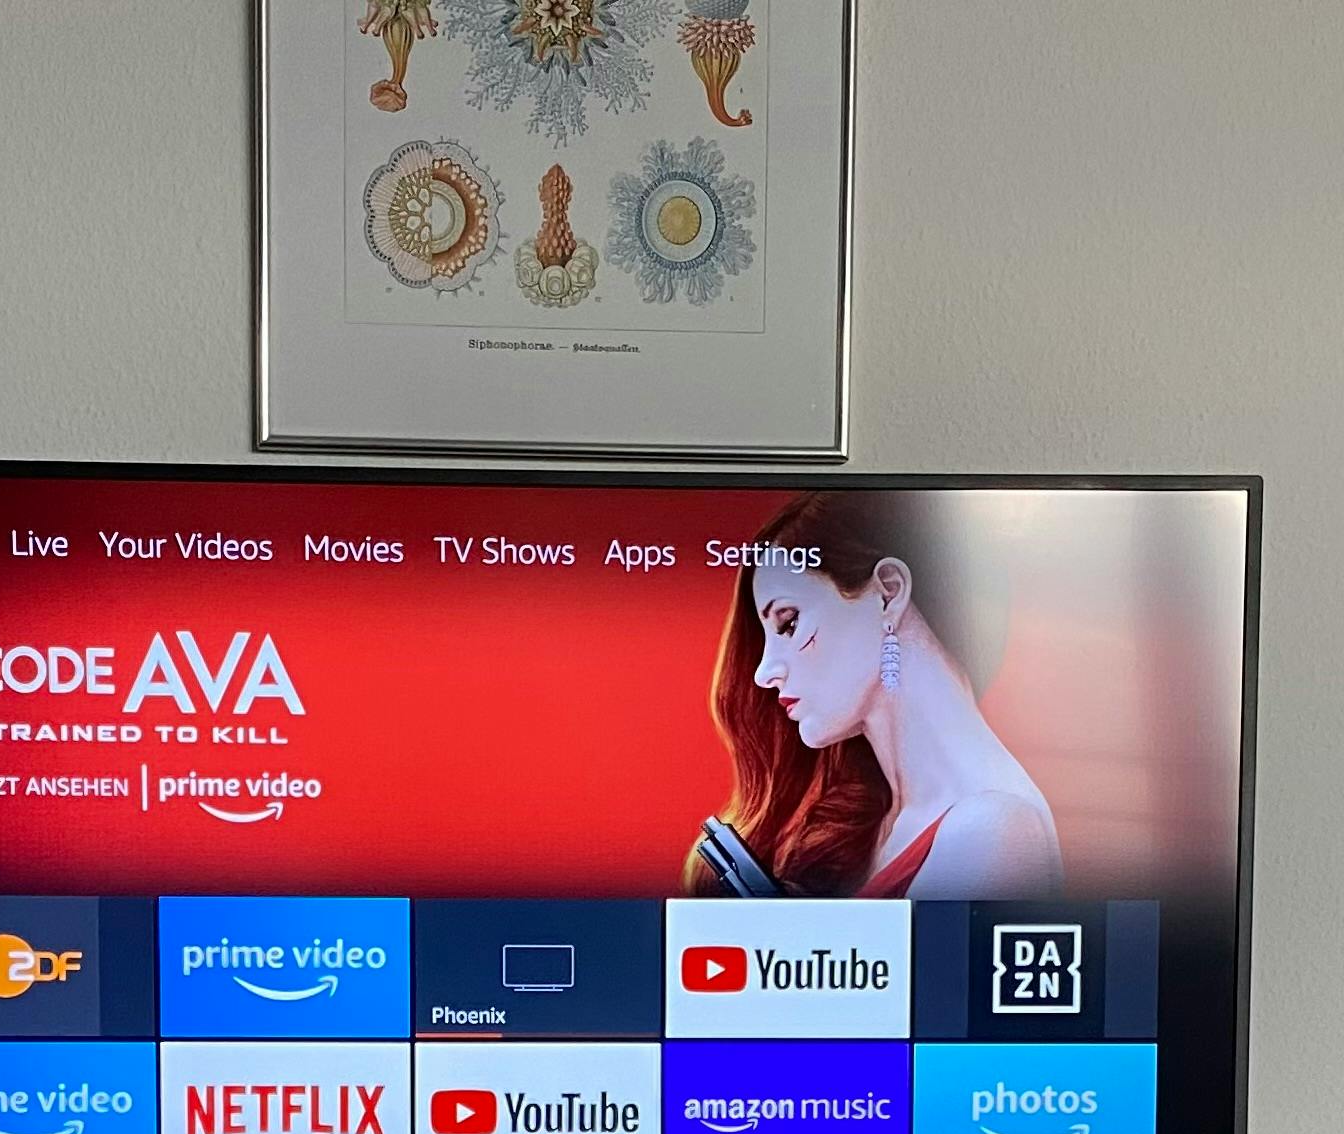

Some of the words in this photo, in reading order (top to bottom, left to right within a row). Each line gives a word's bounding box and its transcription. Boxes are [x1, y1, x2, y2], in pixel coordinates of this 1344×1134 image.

[11, 530, 68, 557] Live
[99, 531, 167, 559] Your
[175, 532, 274, 561] Videos
[304, 535, 404, 563] Movies
[434, 537, 474, 564] TV
[482, 537, 575, 566] Shows
[605, 540, 676, 572] Apps
[705, 540, 822, 574] Settings
[122, 630, 306, 716] AVA
[155, 725, 198, 743] TO
[212, 726, 289, 744] KILL
[25, 777, 129, 797] ANSEHEN
[159, 772, 240, 802] prime
[245, 773, 322, 799] video
[8, 950, 83, 983] ZDF
[182, 938, 284, 975] prime
[294, 938, 387, 970] video
[755, 949, 890, 991] YouTube
[431, 1006, 507, 1026] Phoenix
[39, 1083, 133, 1114] video
[504, 1093, 640, 1133] YouTube
[684, 1096, 795, 1121] amazon
[801, 1093, 891, 1120] music
[972, 1082, 1098, 1121] photos
